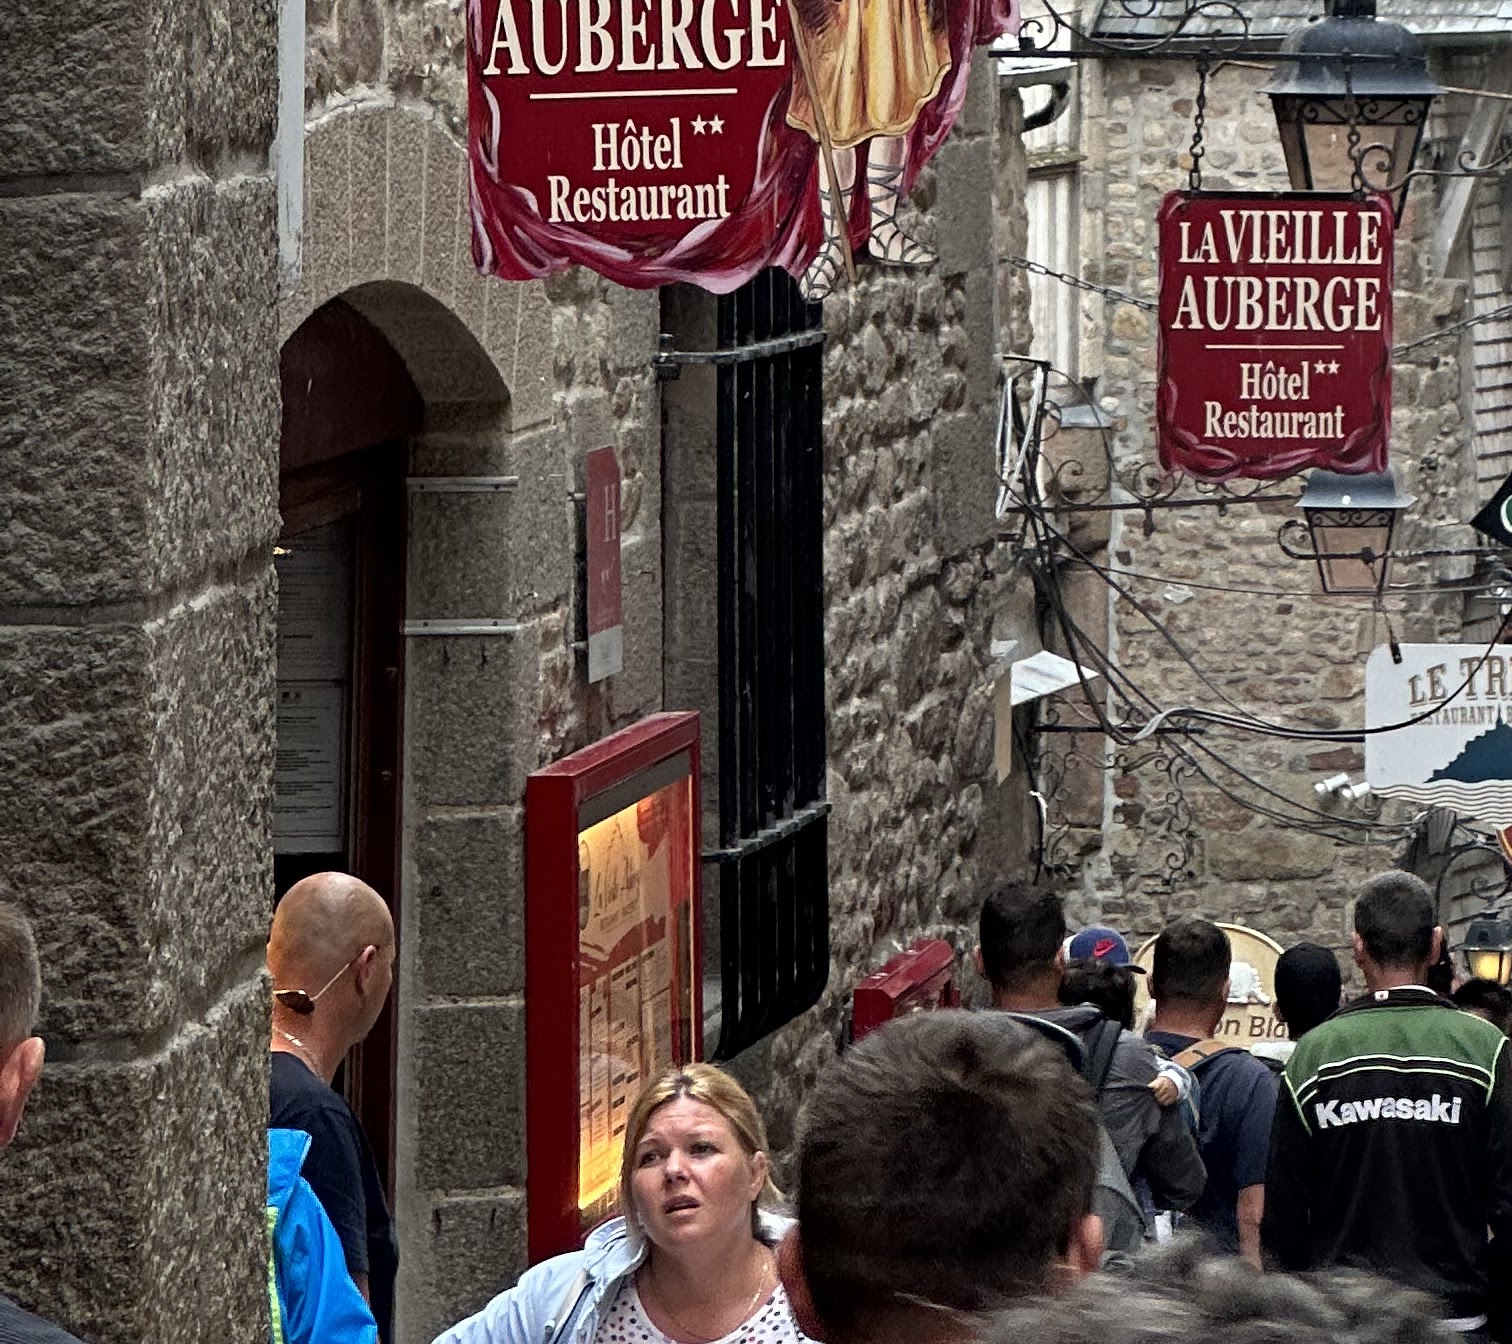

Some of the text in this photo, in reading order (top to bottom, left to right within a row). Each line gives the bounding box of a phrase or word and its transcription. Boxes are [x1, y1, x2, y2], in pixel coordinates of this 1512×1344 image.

[592, 116, 683, 172] Hôtel
[548, 175, 731, 223] Restaurant
[1179, 209, 1383, 265] LA VIEILLE
[1171, 275, 1382, 332] AUBERGE
[1240, 360, 1310, 400] Hôtel
[1204, 400, 1345, 439] Restaurant
[1408, 662, 1449, 707] LE
[1250, 1016, 1287, 1038] Bla
[1314, 1093, 1462, 1130] Kawasaki
